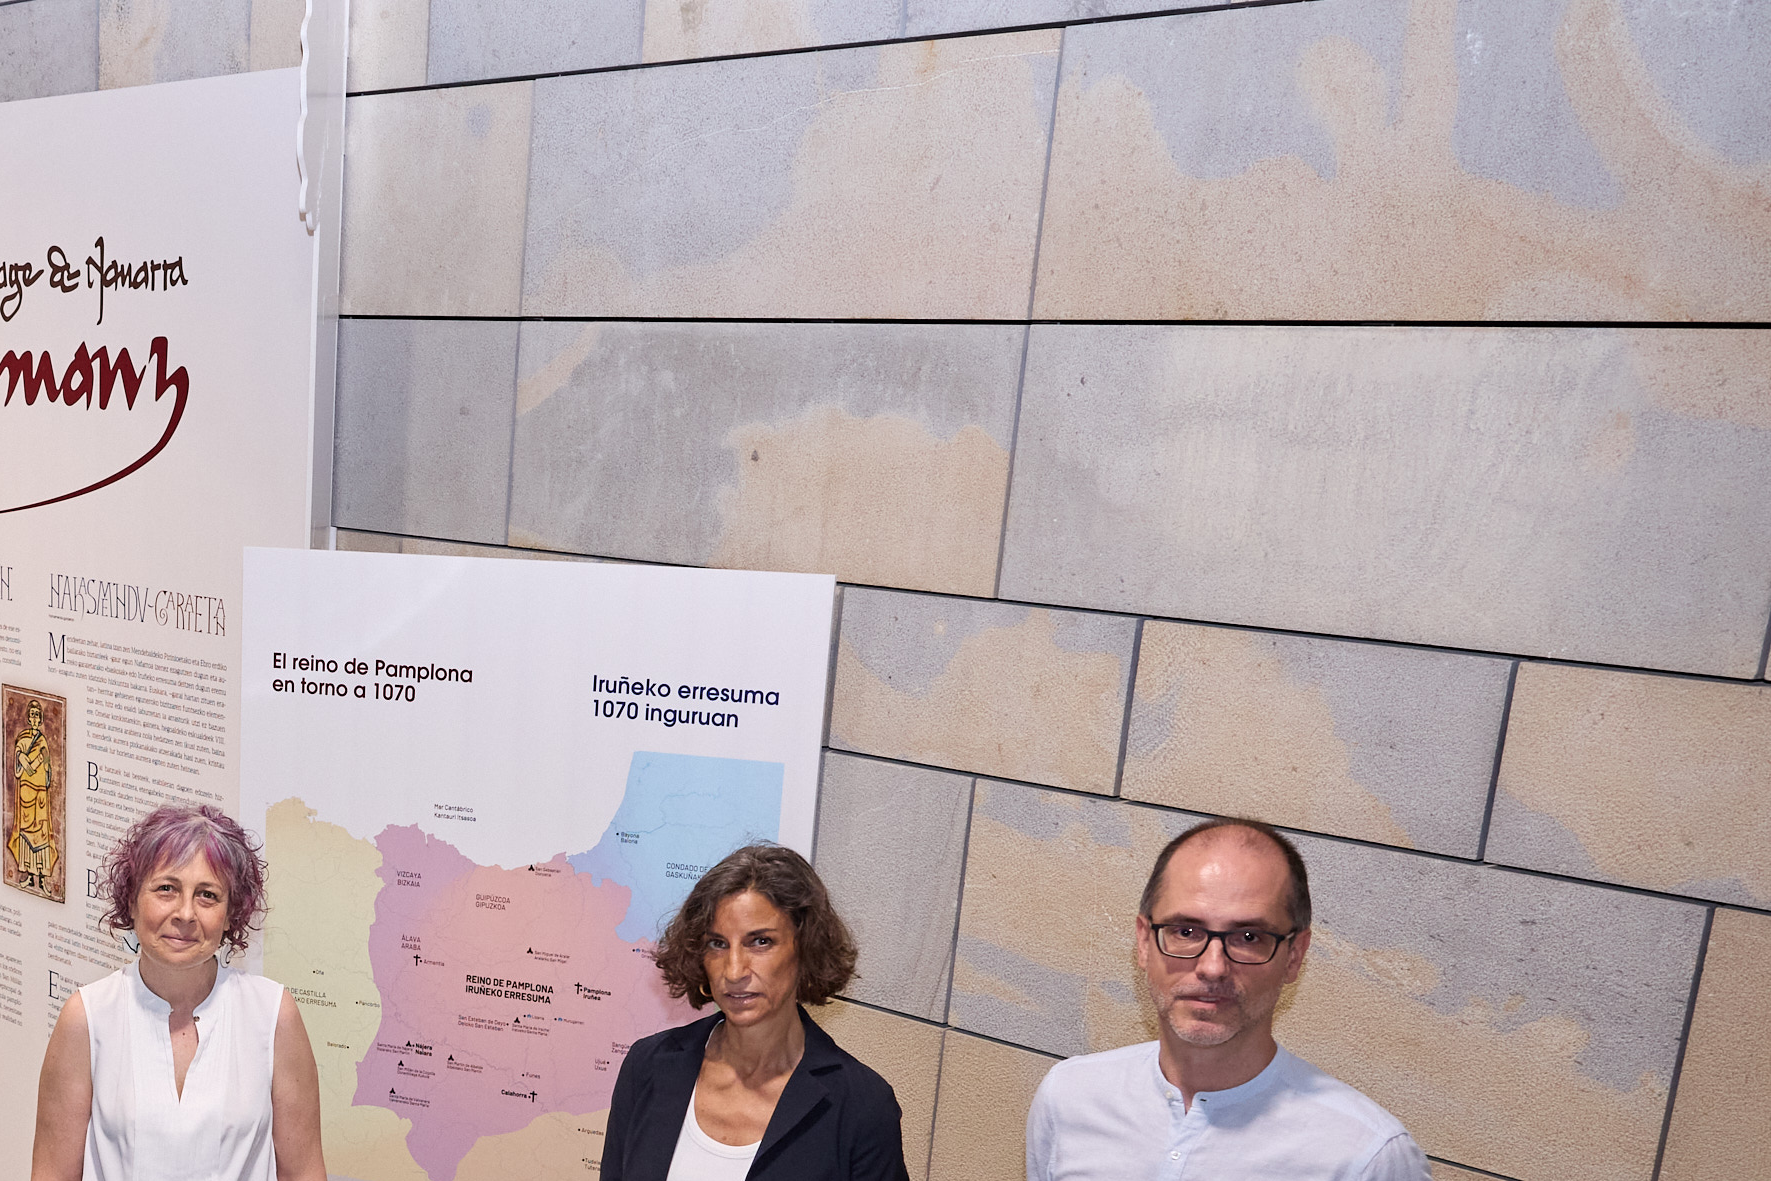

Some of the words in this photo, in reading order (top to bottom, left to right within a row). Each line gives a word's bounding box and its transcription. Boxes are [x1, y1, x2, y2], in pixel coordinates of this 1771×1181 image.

[273, 652, 286, 669] El
[293, 655, 338, 673] reino
[344, 658, 368, 675] de
[375, 659, 473, 683] Pamplona
[272, 678, 294, 693] en
[301, 677, 348, 697] torno
[354, 684, 366, 698] a
[374, 683, 416, 702] 1070
[592, 674, 671, 697] Iruñeko
[678, 684, 779, 706] erresuma
[593, 699, 639, 720] 1070
[645, 703, 739, 728] inguruan
[434, 803, 443, 811] Mar
[444, 804, 474, 813] Cantábrico
[666, 862, 698, 872] CONDADO
[699, 865, 708, 873] DE
[396, 870, 422, 880] VIZCAYA
[397, 879, 421, 888] BIZKAIA
[475, 893, 511, 905] GUIPÚZCOA
[475, 901, 506, 911] GIPUZKOA
[402, 934, 421, 943] ÁLAVA
[401, 942, 421, 951] ARABA
[465, 974, 492, 986] REINO
[493, 978, 504, 988] DE
[506, 980, 554, 995] PAMPLONA
[299, 988, 326, 998] CASTILLA
[465, 984, 503, 998] IRUÑEKO
[504, 991, 551, 1005] ERRESUMA
[583, 987, 611, 996] Pamplona
[583, 993, 601, 1001] Iruñea
[306, 997, 337, 1008] ERRESUMA
[501, 1089, 527, 1098] Calahorra
